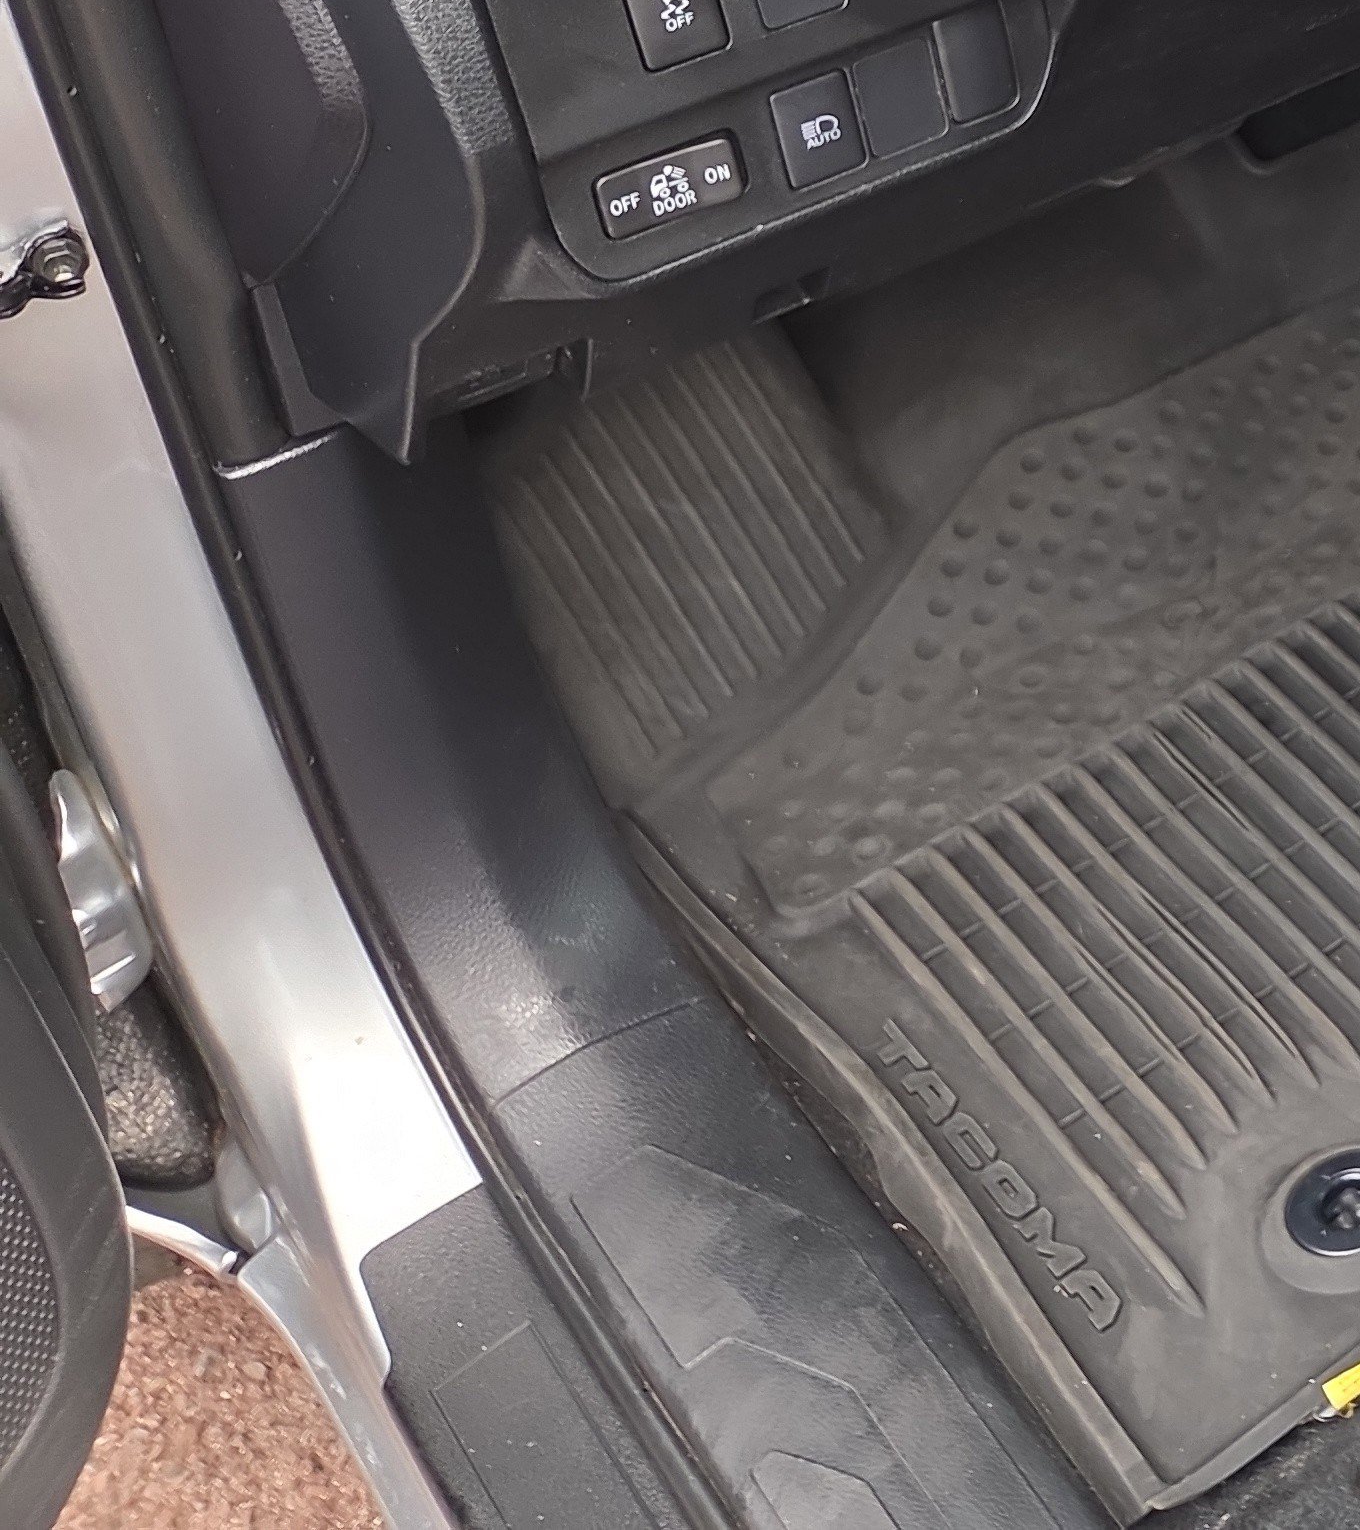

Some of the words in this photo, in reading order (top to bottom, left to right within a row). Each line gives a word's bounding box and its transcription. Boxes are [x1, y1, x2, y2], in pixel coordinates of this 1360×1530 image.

[665, 11, 695, 33] OFF
[806, 126, 842, 150] AUTO
[608, 191, 641, 217] OFF
[703, 163, 732, 185] ON
[651, 189, 698, 217] DOOR
[877, 1018, 1123, 1334] TACOMA
